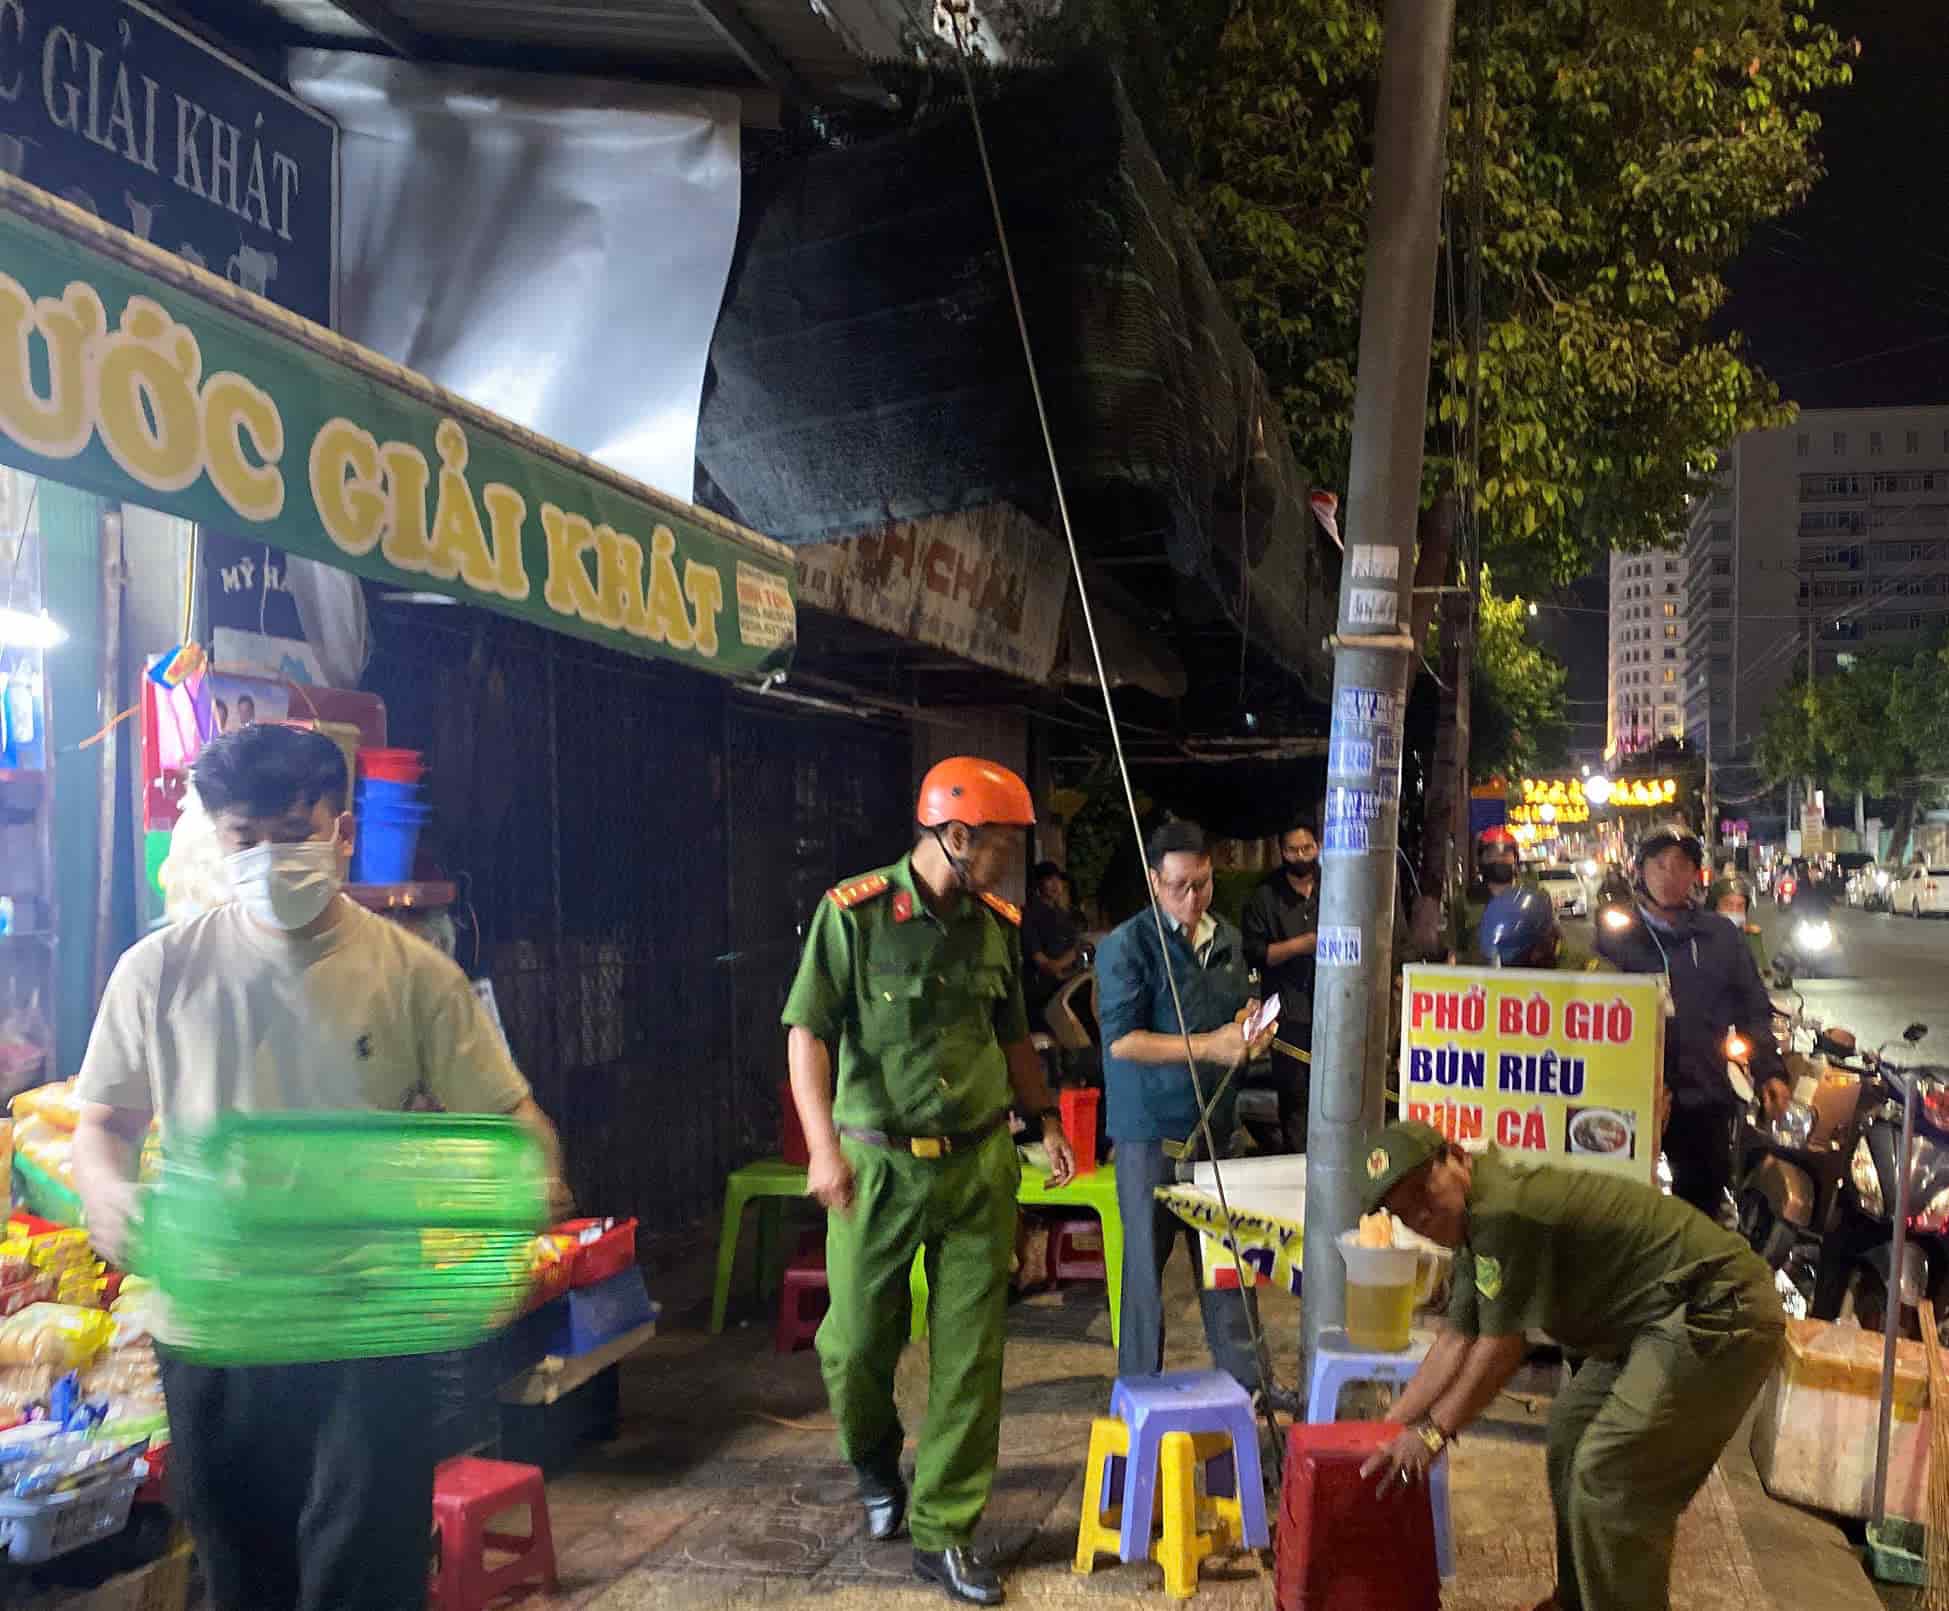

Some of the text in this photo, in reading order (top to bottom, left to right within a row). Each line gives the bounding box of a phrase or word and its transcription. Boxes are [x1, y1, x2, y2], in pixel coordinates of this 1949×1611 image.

[42, 18, 159, 175] GIẢI
[174, 94, 299, 241] KHÁT
[309, 417, 530, 600] GIẢI
[541, 502, 723, 657] KHÁT
[1410, 984, 1633, 1044] PHỞ BÒ GIÒ
[1409, 1043, 1585, 1097] BÚN RIÊU
[1496, 1103, 1548, 1151] CÁ
